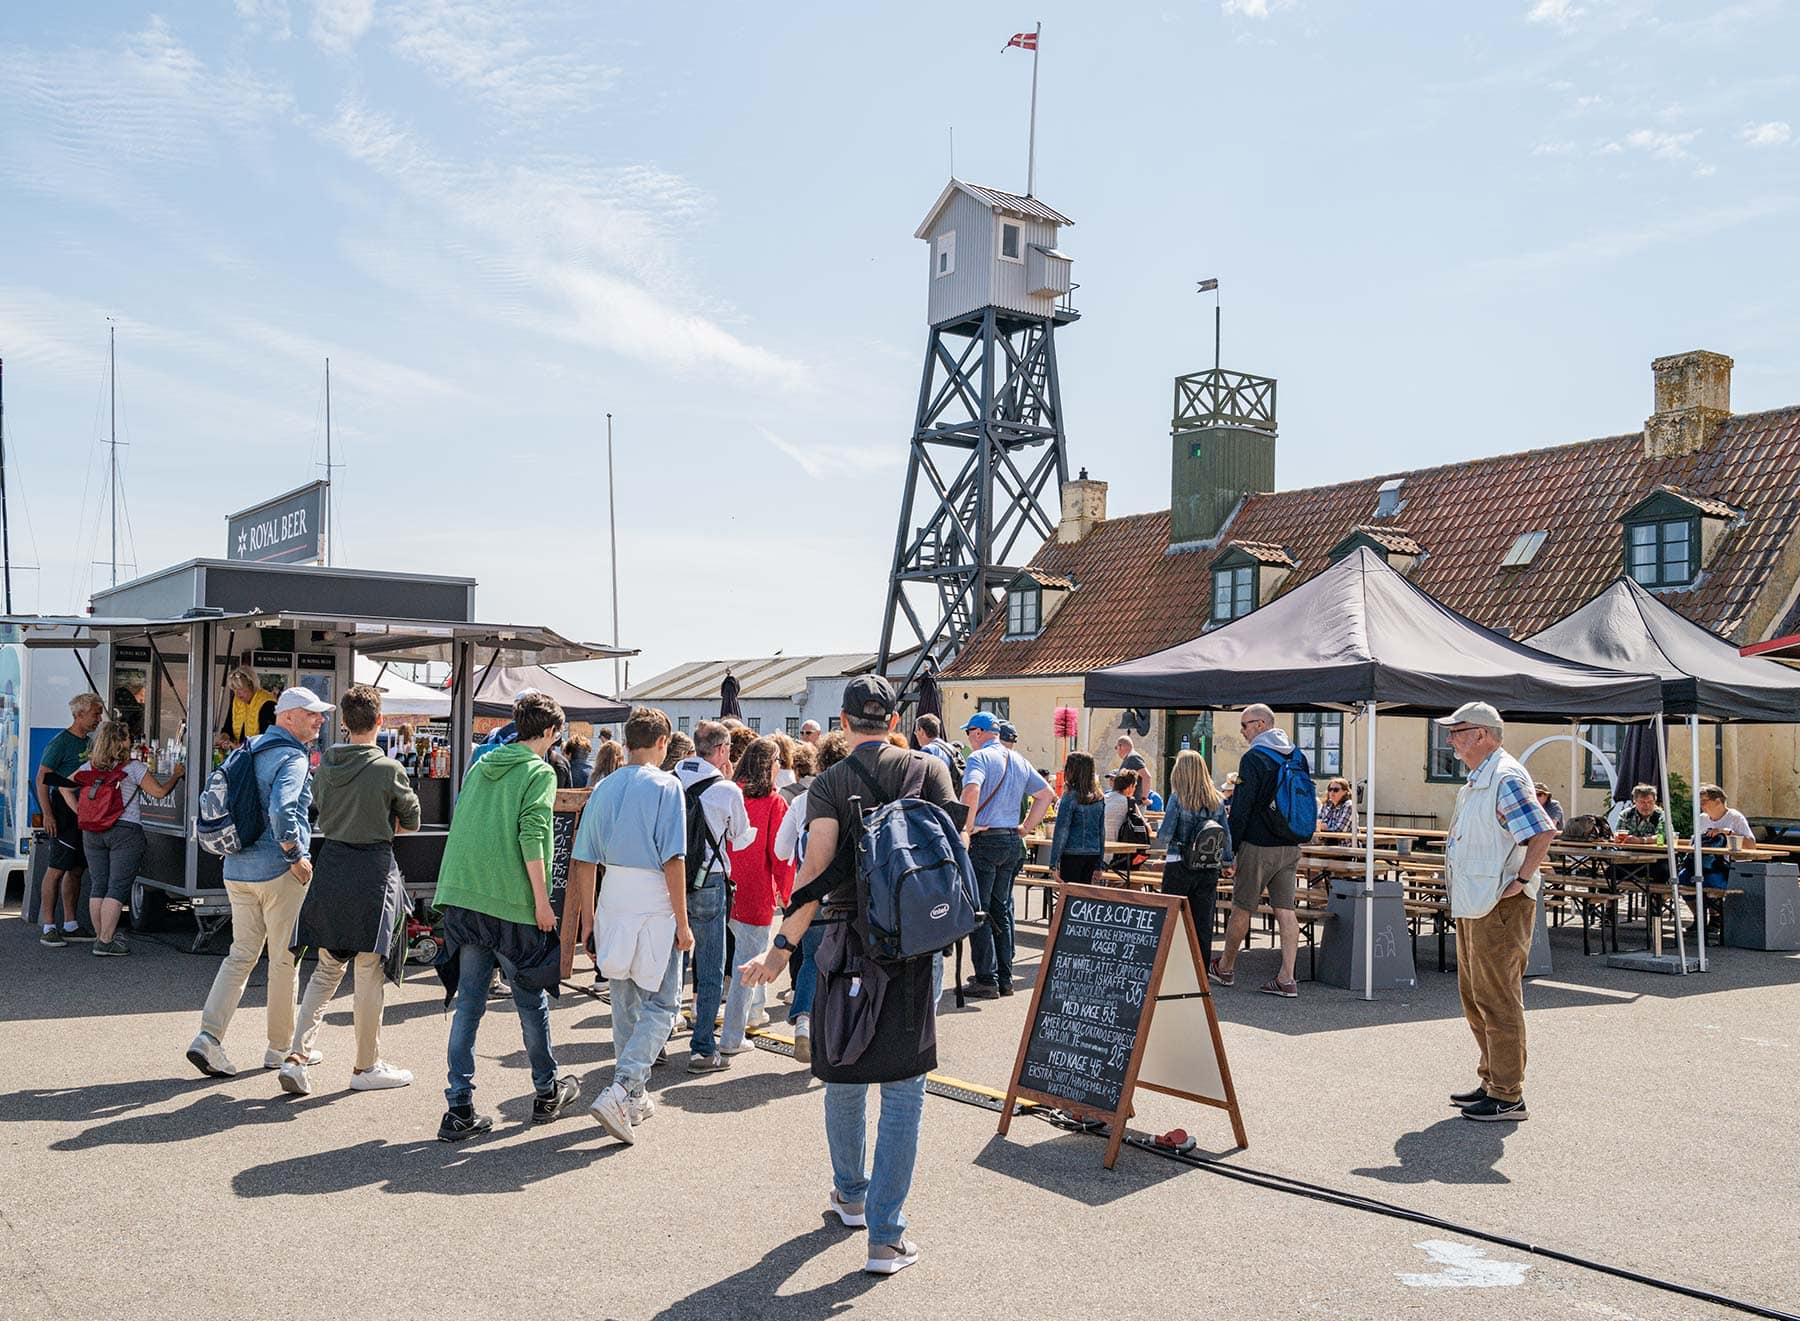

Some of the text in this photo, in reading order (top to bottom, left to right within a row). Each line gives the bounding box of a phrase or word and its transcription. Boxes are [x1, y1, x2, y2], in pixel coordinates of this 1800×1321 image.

[249, 508, 308, 552] ROYAL BEER
[1071, 901, 1104, 921] CAKE
[1115, 906, 1156, 929] COFFEE
[1065, 925, 1091, 937] DAGENS
[1091, 940, 1117, 955] KAGER
[1056, 956, 1071, 968] FLAT
[1062, 1001, 1079, 1015] MED
[1080, 1004, 1100, 1019] KAGE
[1048, 1051, 1066, 1066] MED
[1067, 1052, 1088, 1071] KAGE
[1028, 1065, 1052, 1080] EKSTRA
